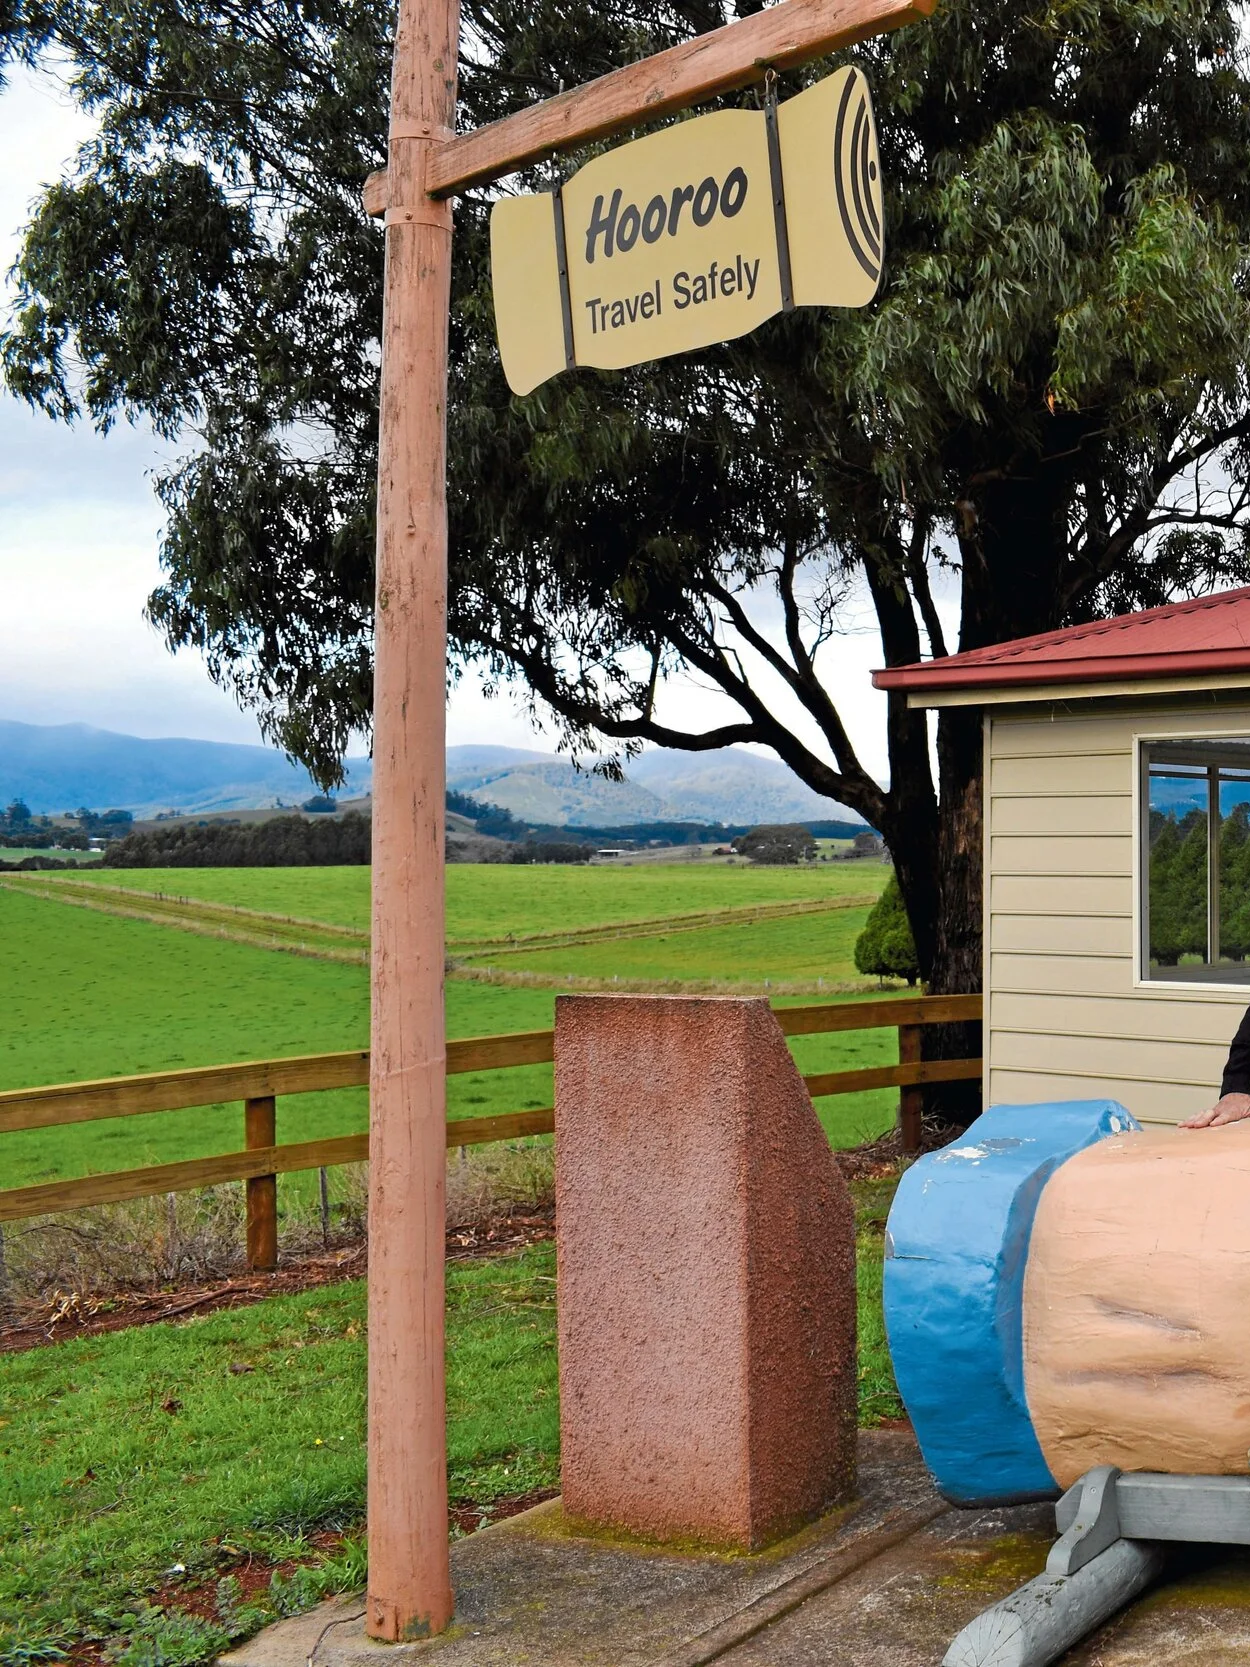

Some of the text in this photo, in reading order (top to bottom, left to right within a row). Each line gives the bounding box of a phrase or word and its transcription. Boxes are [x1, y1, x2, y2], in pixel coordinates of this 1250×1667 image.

[585, 167, 749, 264] Hooroo
[585, 254, 760, 334] Travel Safely
